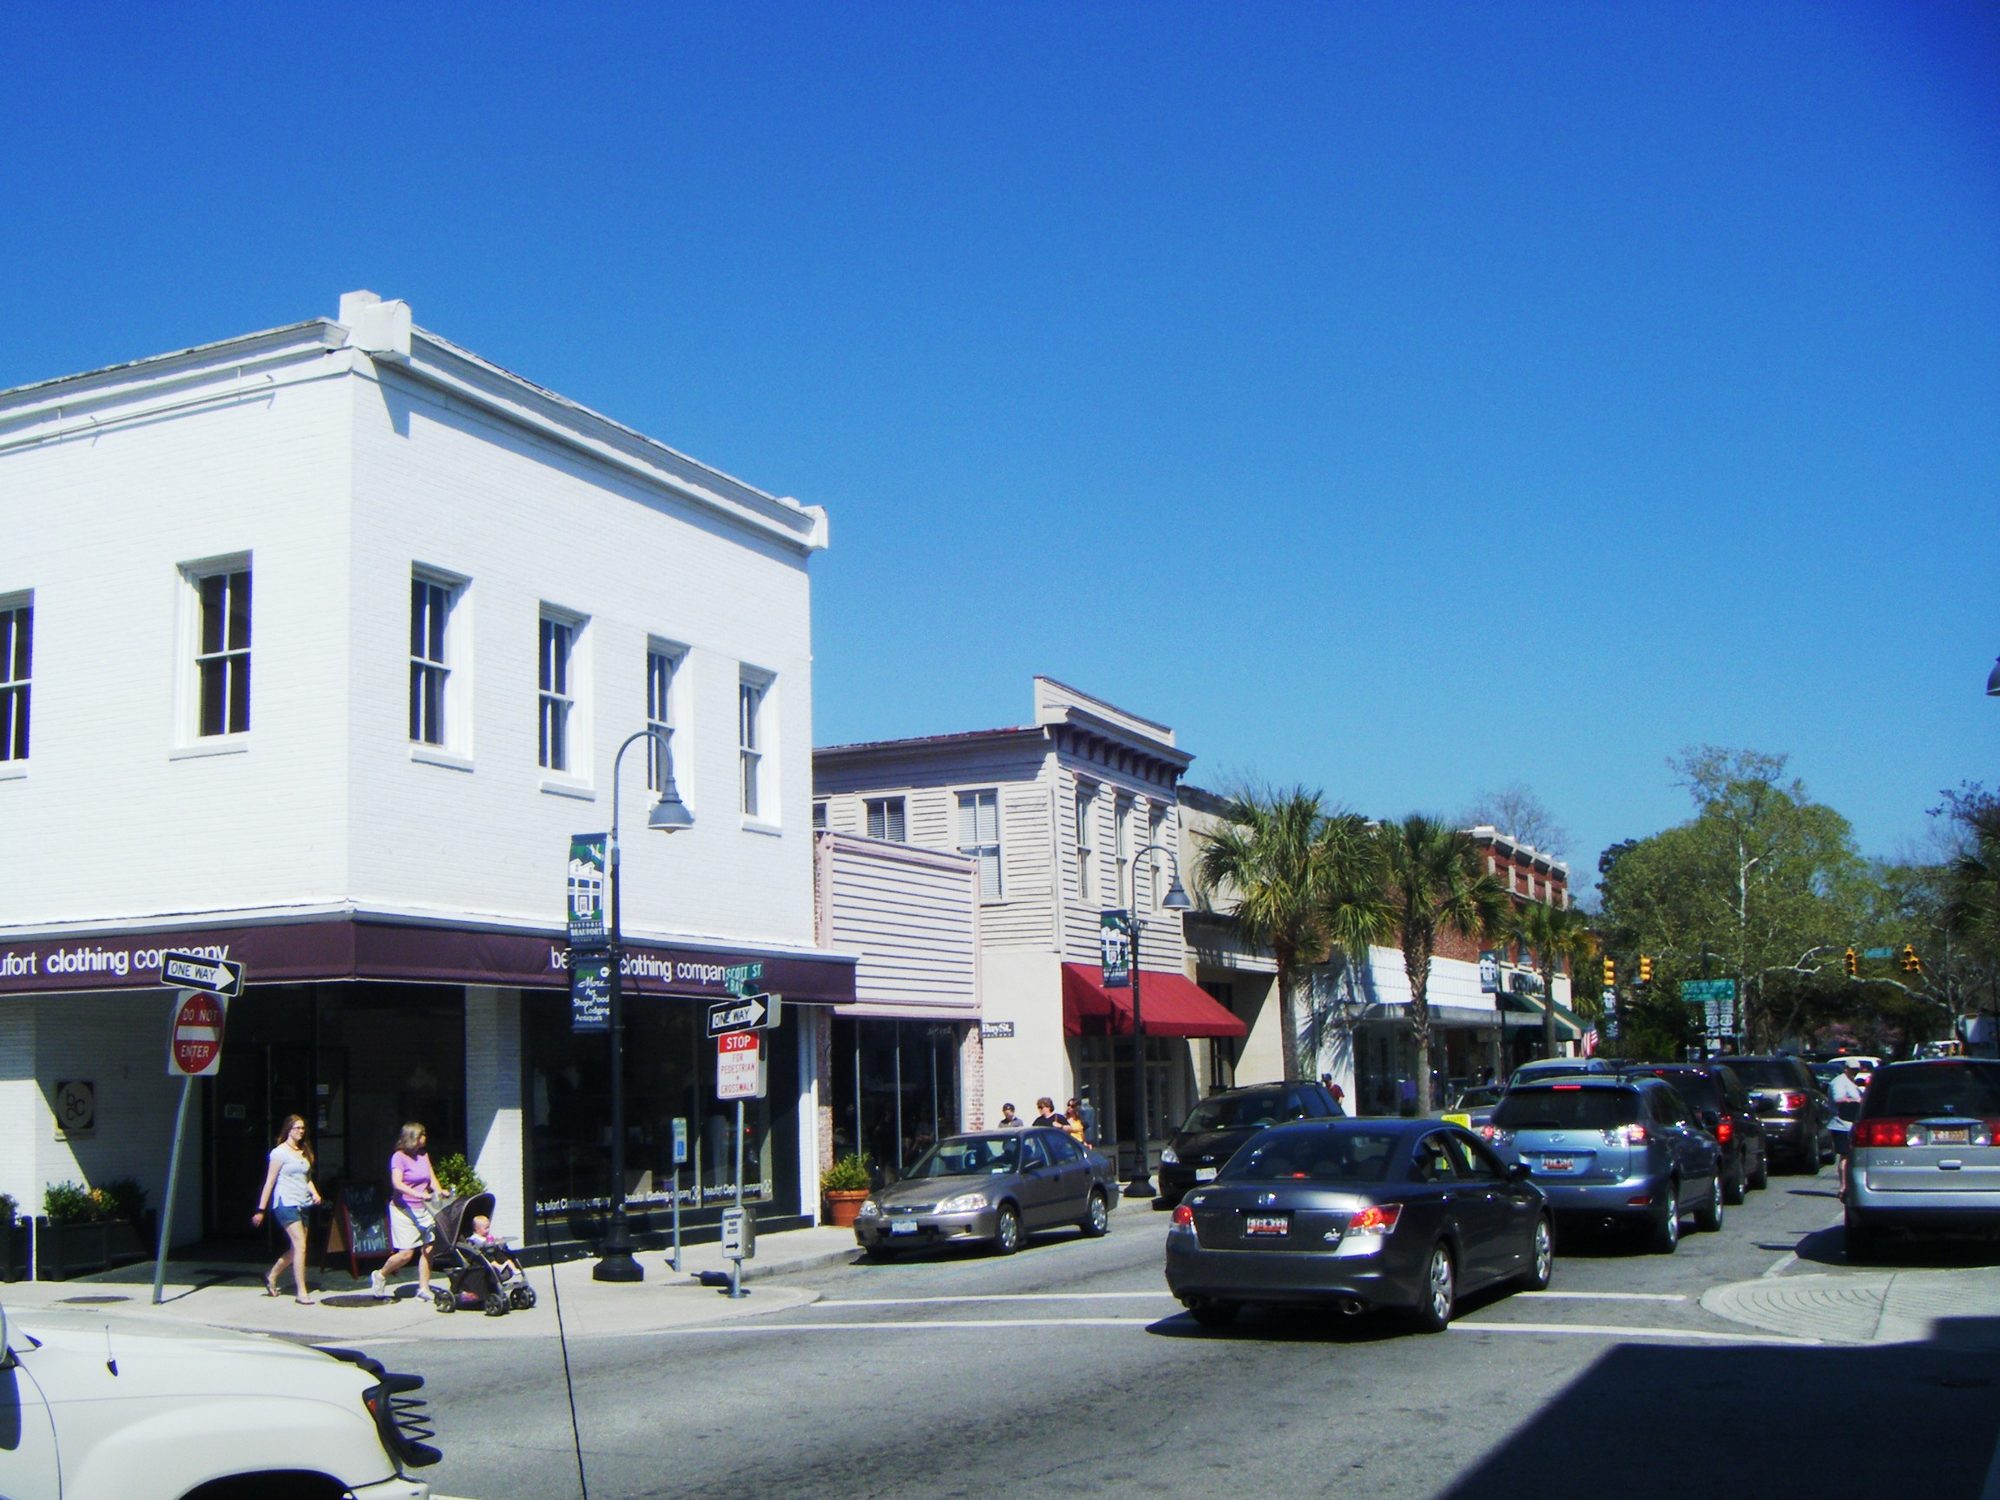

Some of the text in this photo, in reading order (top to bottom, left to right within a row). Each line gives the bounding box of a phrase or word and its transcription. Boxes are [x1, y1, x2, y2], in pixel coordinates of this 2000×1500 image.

[47, 947, 129, 975] clothing
[170, 962, 216, 981] ONE WAY
[620, 953, 672, 983] clothing
[677, 962, 727, 986] compan
[726, 963, 762, 979] SCOTT ST
[577, 975, 611, 988] More
[592, 993, 610, 1003] Food
[183, 1008, 218, 1022] DO NOT
[714, 1008, 750, 1026] ONE WAY
[726, 1035, 751, 1050] STOP
[181, 1044, 210, 1058] ENTER
